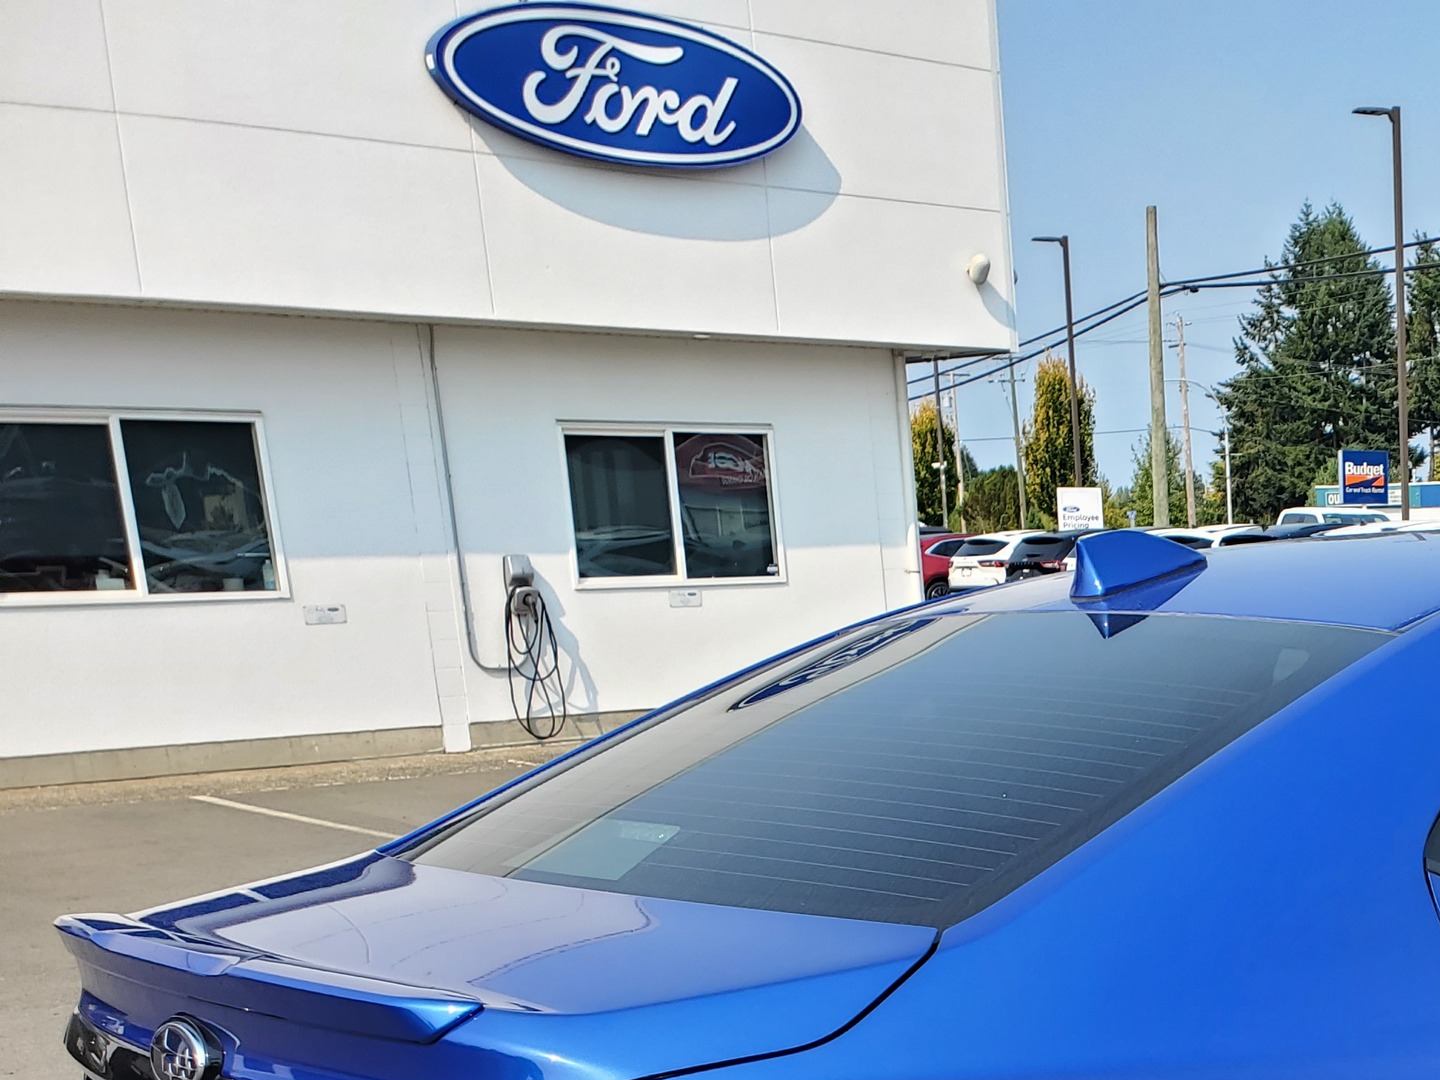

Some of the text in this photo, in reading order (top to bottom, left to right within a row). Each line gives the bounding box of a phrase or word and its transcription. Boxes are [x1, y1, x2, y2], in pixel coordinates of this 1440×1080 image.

[523, 25, 739, 146] Ford
[1344, 461, 1385, 477] Budget
[1062, 513, 1100, 522] Employee
